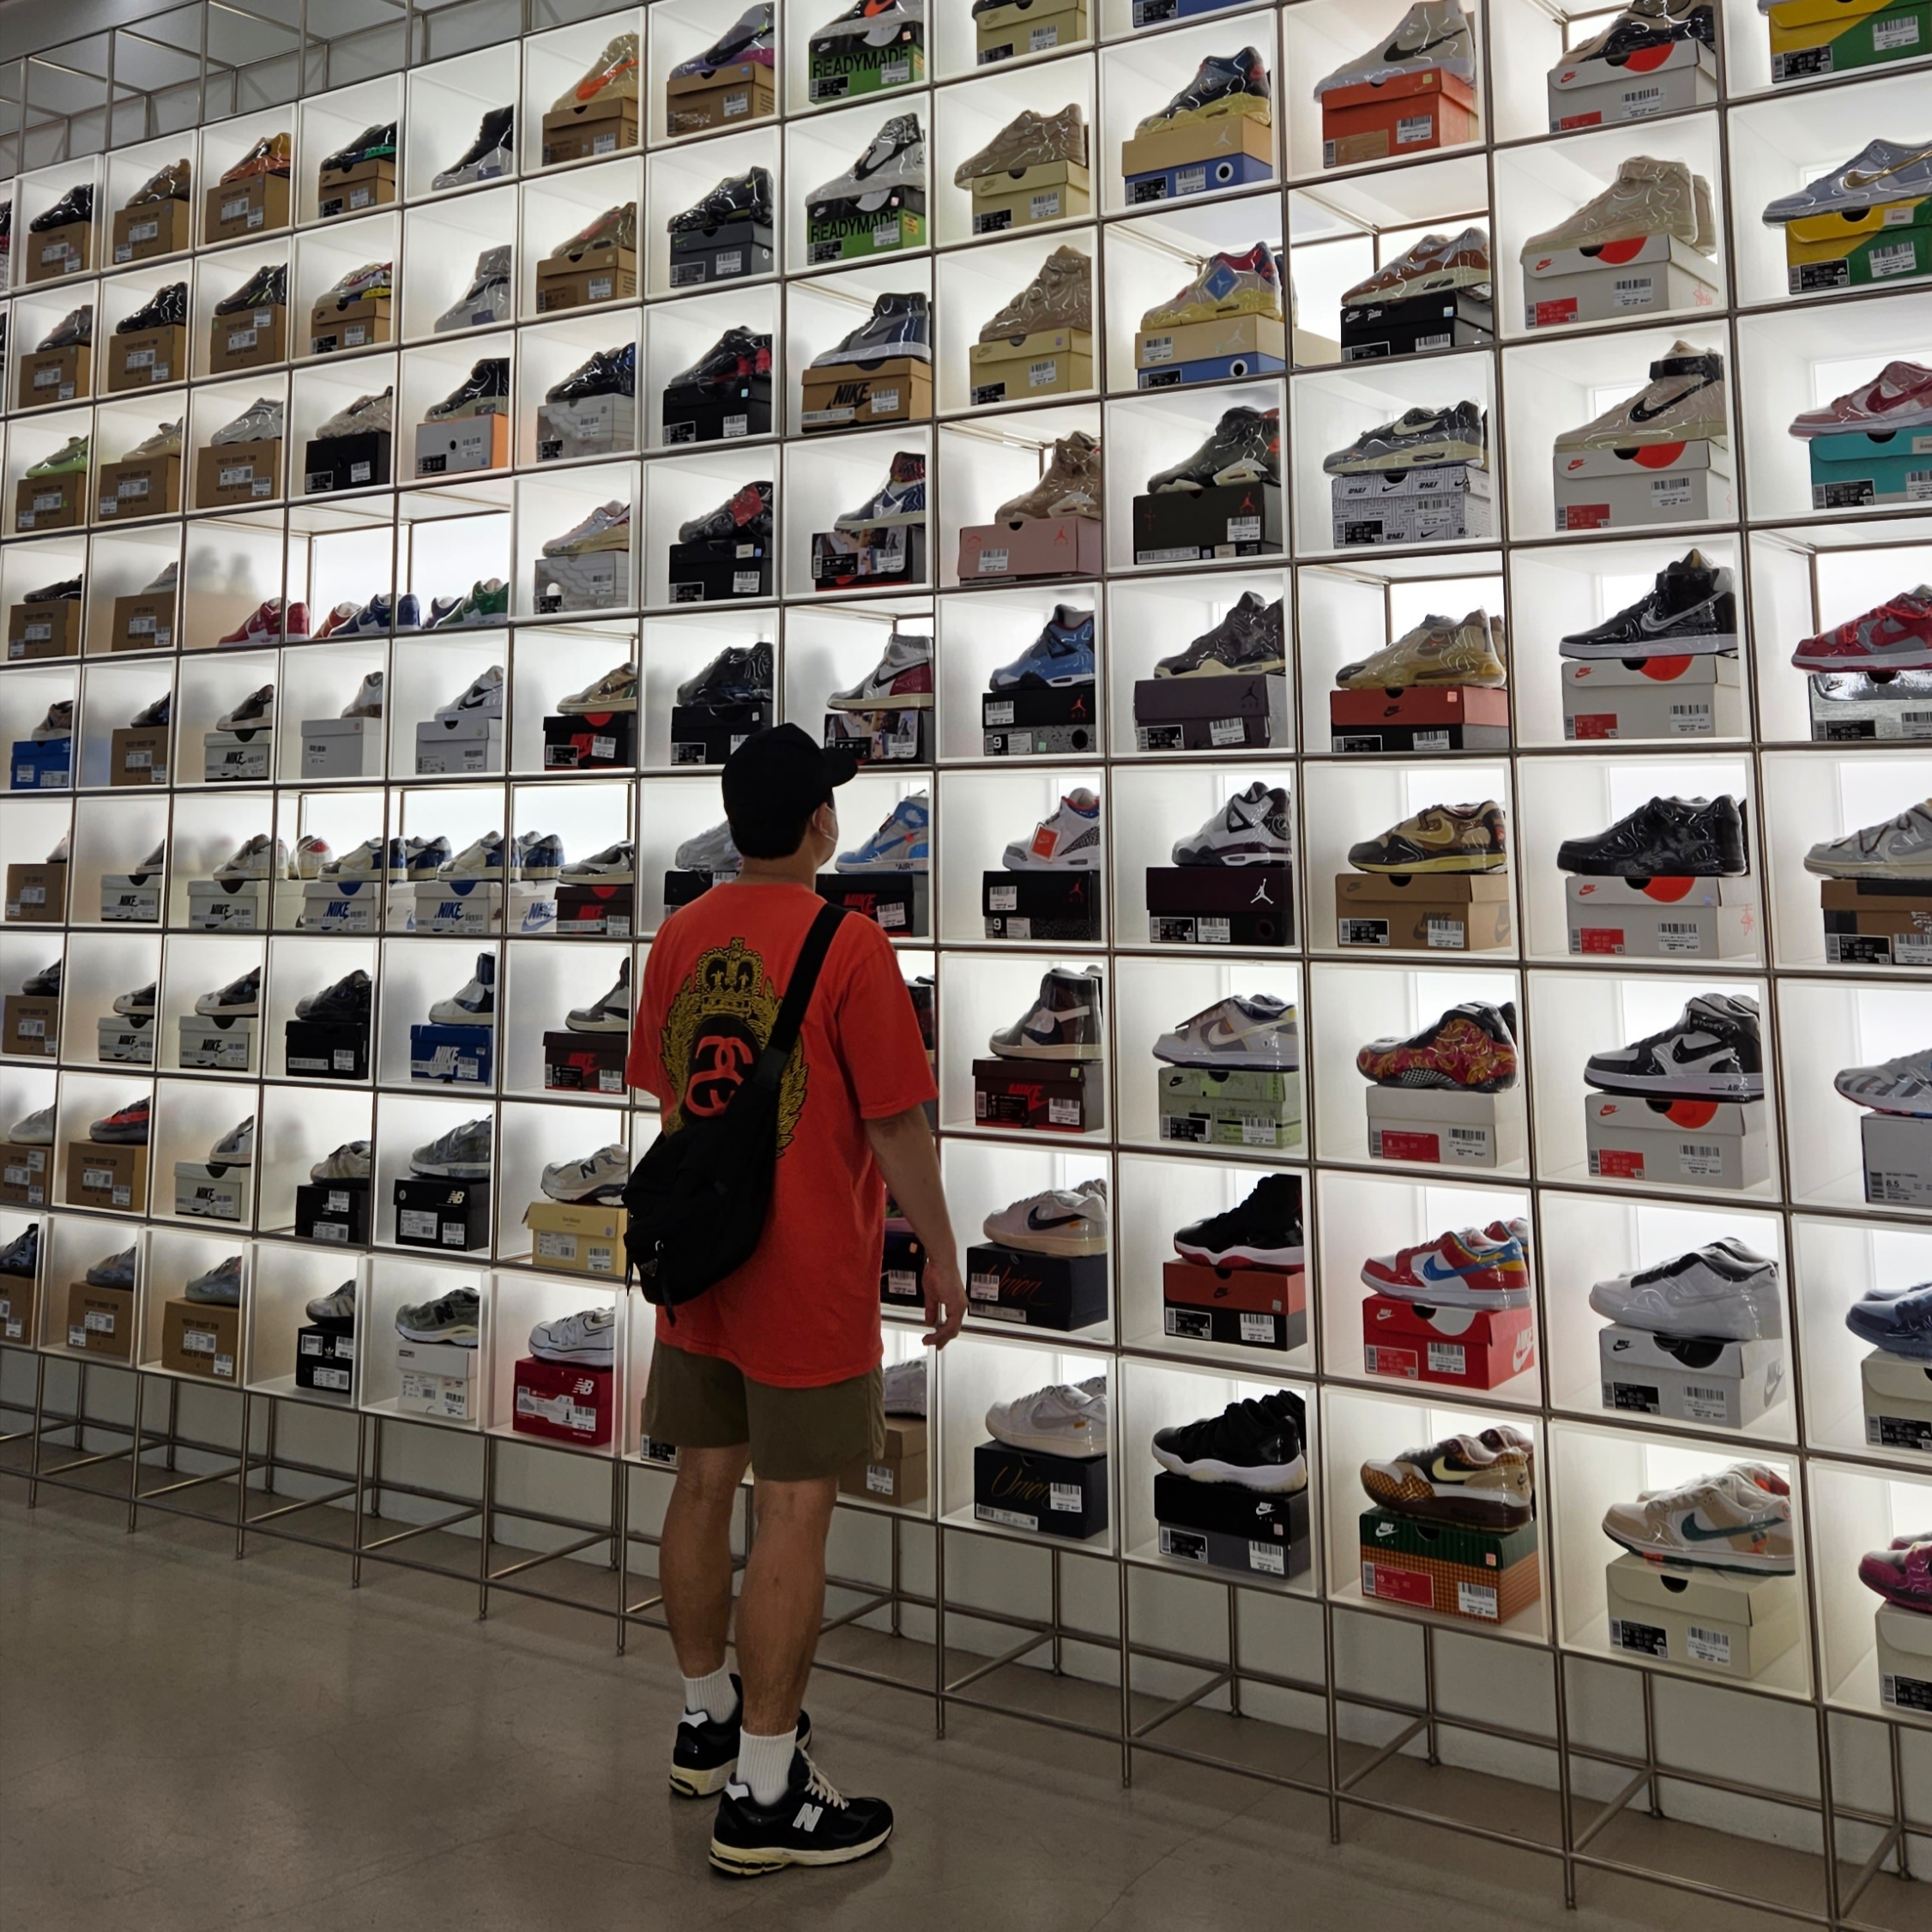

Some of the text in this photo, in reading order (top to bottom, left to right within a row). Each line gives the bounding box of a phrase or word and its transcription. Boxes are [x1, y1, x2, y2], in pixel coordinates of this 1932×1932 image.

[812, 45, 909, 78] READYMADE
[811, 211, 897, 243] READYMADE
[832, 383, 871, 405] NIKE
[993, 736, 1002, 749] 9
[225, 752, 244, 764] NIKE
[119, 895, 137, 907] NIKE
[210, 904, 230, 915] NIKE
[327, 902, 350, 917] NIKE
[438, 902, 463, 918] NIKE
[993, 918, 1002, 931] 9
[118, 1035, 137, 1046] NIKE
[202, 1039, 221, 1051] NIKE
[433, 1046, 461, 1065] NIKE
[568, 1054, 596, 1067] NIKE
[580, 1160, 597, 1179] N
[196, 1187, 214, 1199] NIKE
[434, 1301, 456, 1325] N
[562, 1323, 577, 1346] N
[793, 1802, 824, 1832] N
